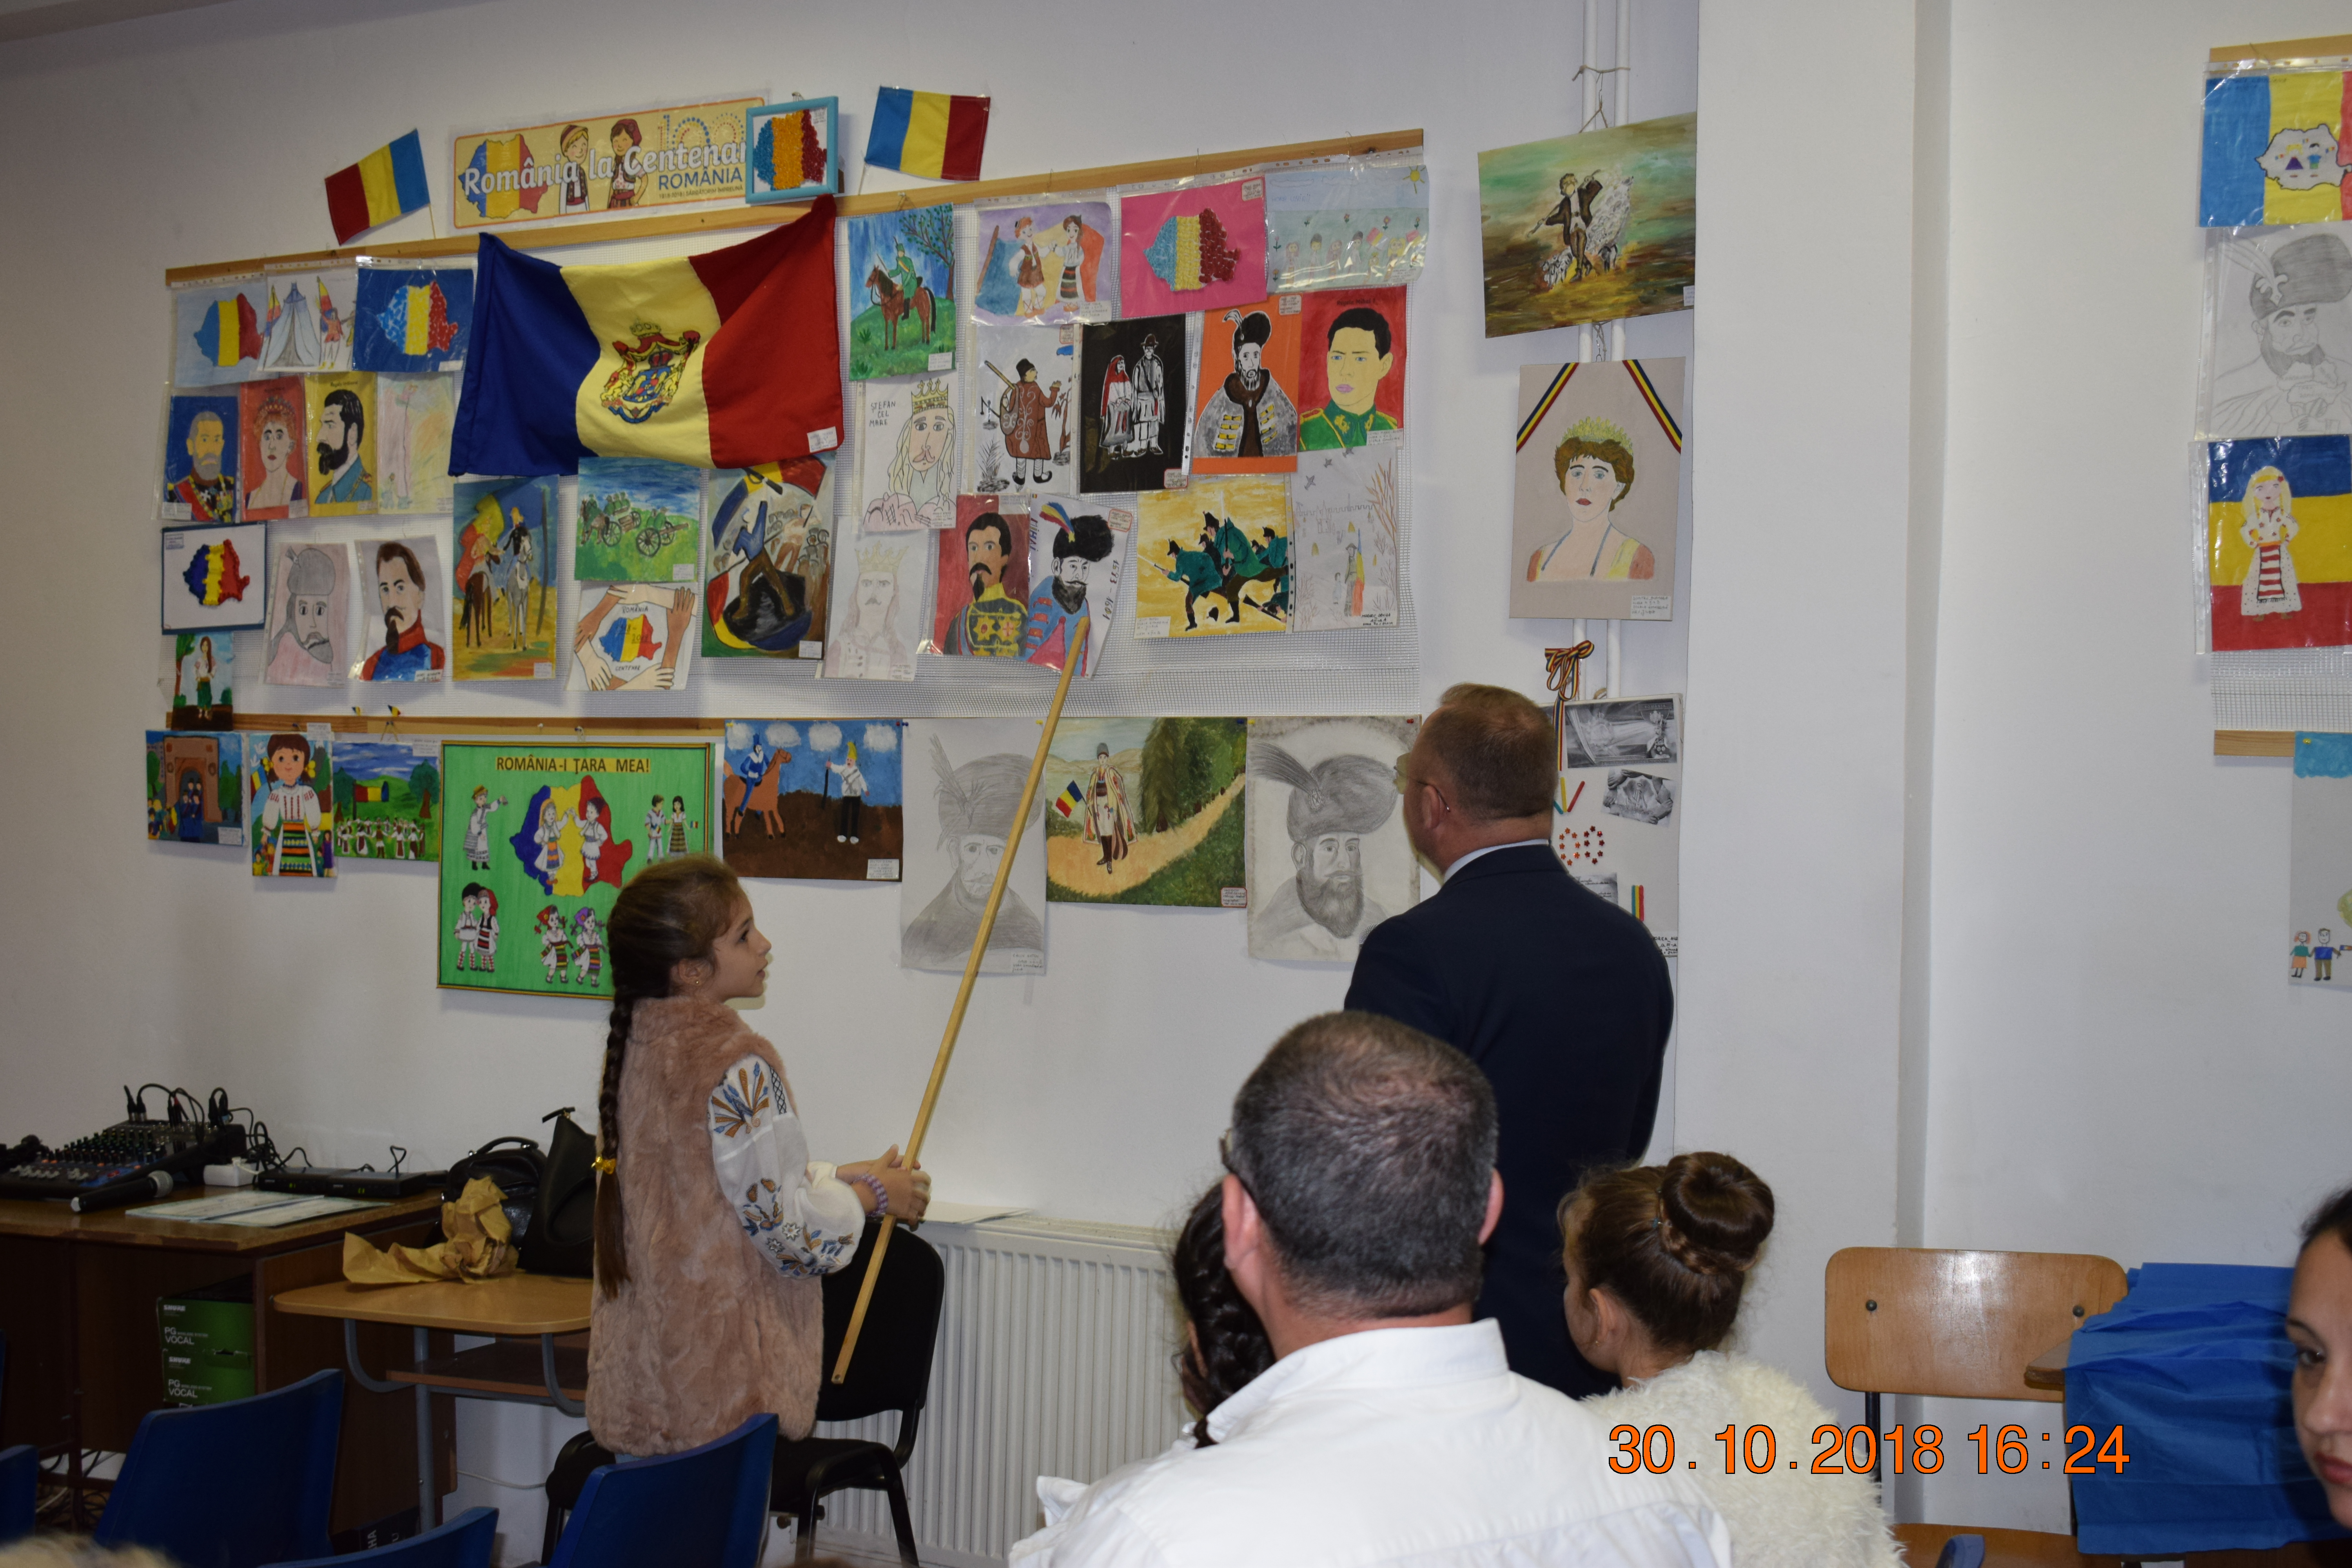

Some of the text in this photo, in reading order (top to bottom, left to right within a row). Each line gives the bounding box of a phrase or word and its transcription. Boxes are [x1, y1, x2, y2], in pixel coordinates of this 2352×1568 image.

[465, 153, 579, 196] România
[589, 148, 614, 180] la
[659, 166, 743, 190] ROMÂNIA
[878, 410, 889, 418] CEL
[869, 419, 887, 427] MARE
[622, 604, 649, 614] ROMÂNIA
[1102, 596, 1114, 620] 1601
[616, 759, 649, 772] MEA!
[165, 1327, 176, 1335] PG
[165, 1336, 195, 1345] VOCAL
[169, 1379, 180, 1388] PG
[169, 1388, 198, 1398] VOCAL
